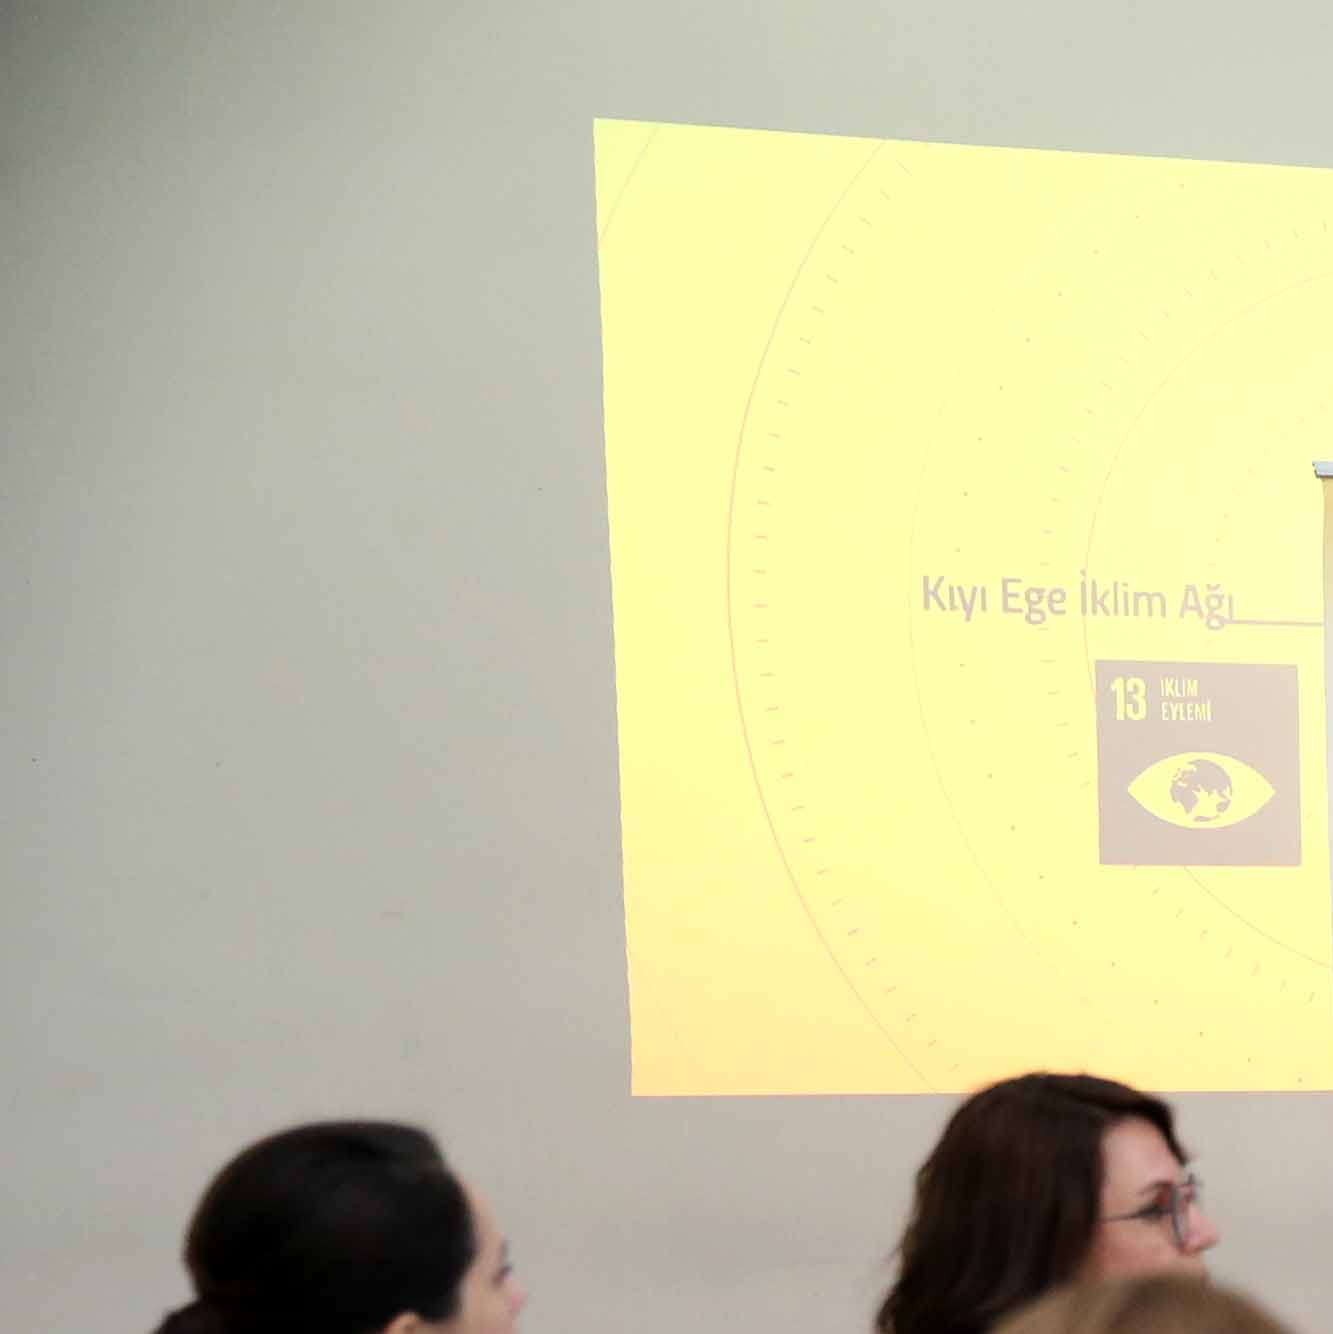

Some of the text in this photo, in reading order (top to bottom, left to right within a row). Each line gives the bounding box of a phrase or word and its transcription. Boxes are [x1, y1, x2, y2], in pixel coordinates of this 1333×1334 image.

[922, 569, 1234, 631] Kıyı Ege İklim Ağı
[1111, 676, 1198, 721] 13 İKLİM
[1161, 699, 1212, 721] EYLEMİ
